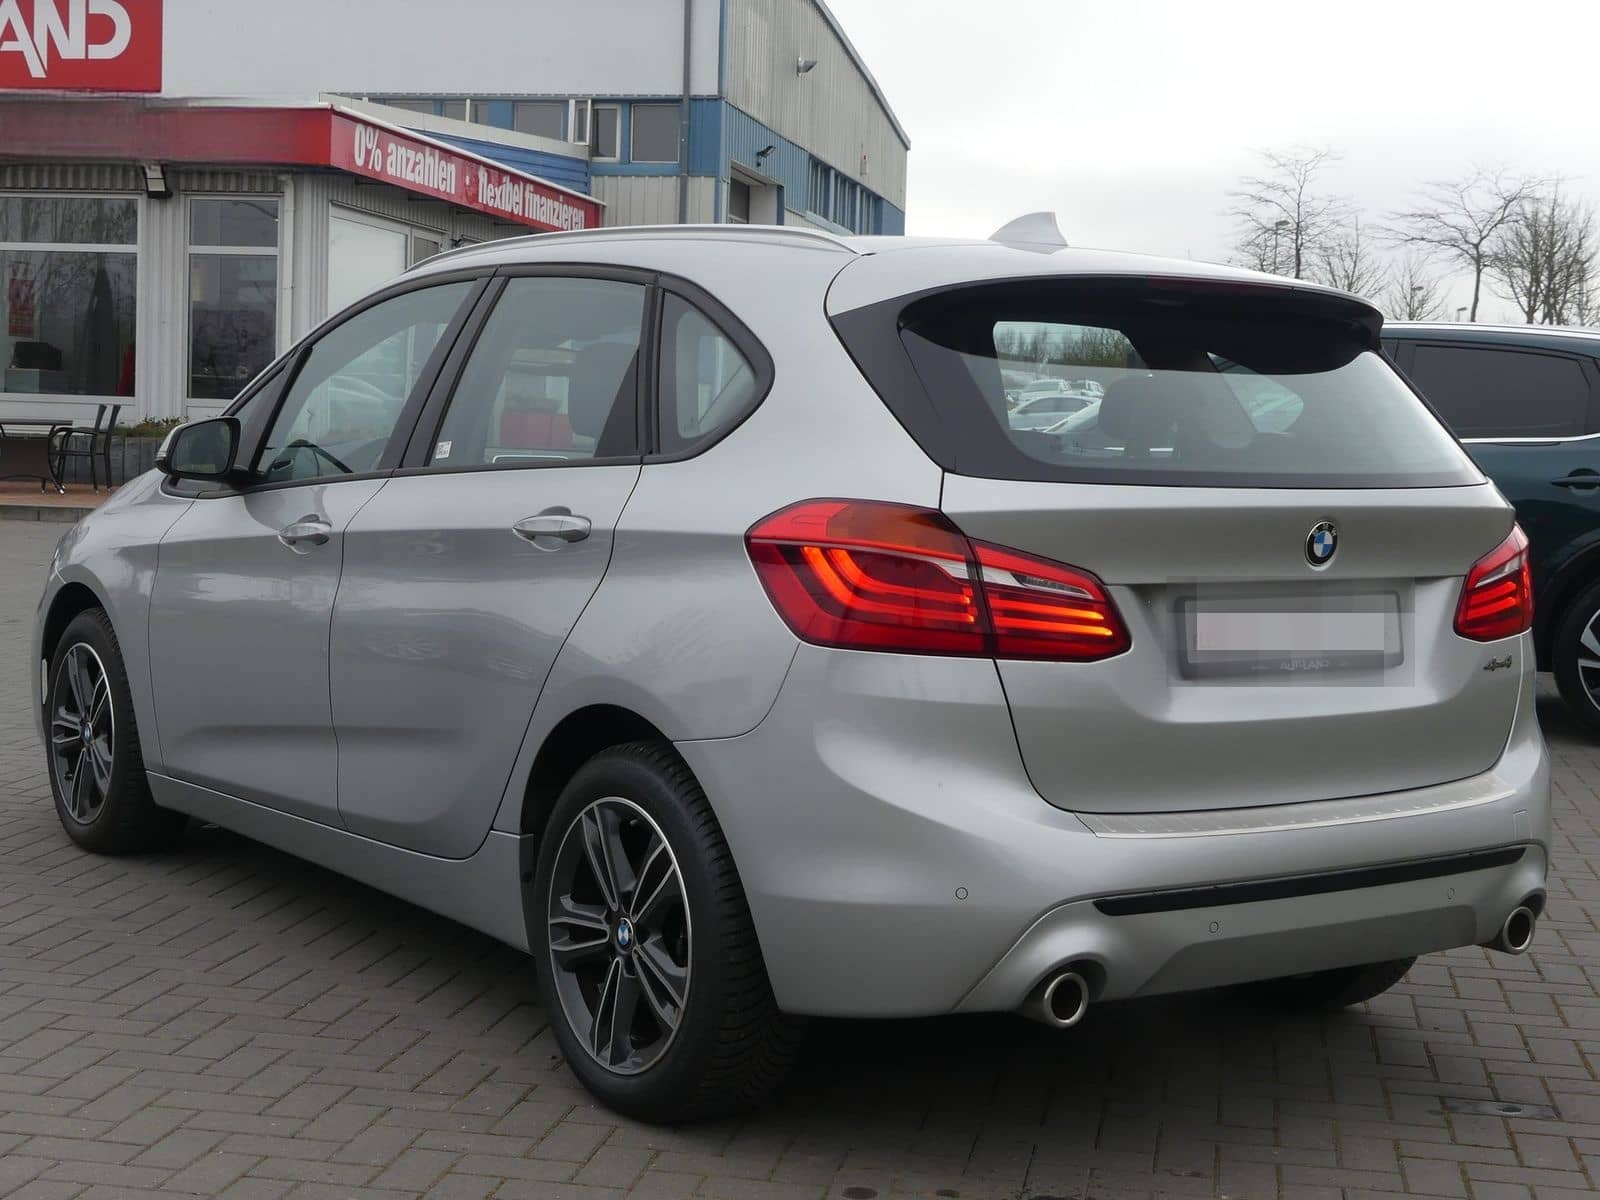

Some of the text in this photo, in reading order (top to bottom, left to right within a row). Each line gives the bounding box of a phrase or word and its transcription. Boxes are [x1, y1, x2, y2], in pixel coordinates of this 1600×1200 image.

[353, 124, 586, 232] 0% anzahlen flexibel finanzieren
